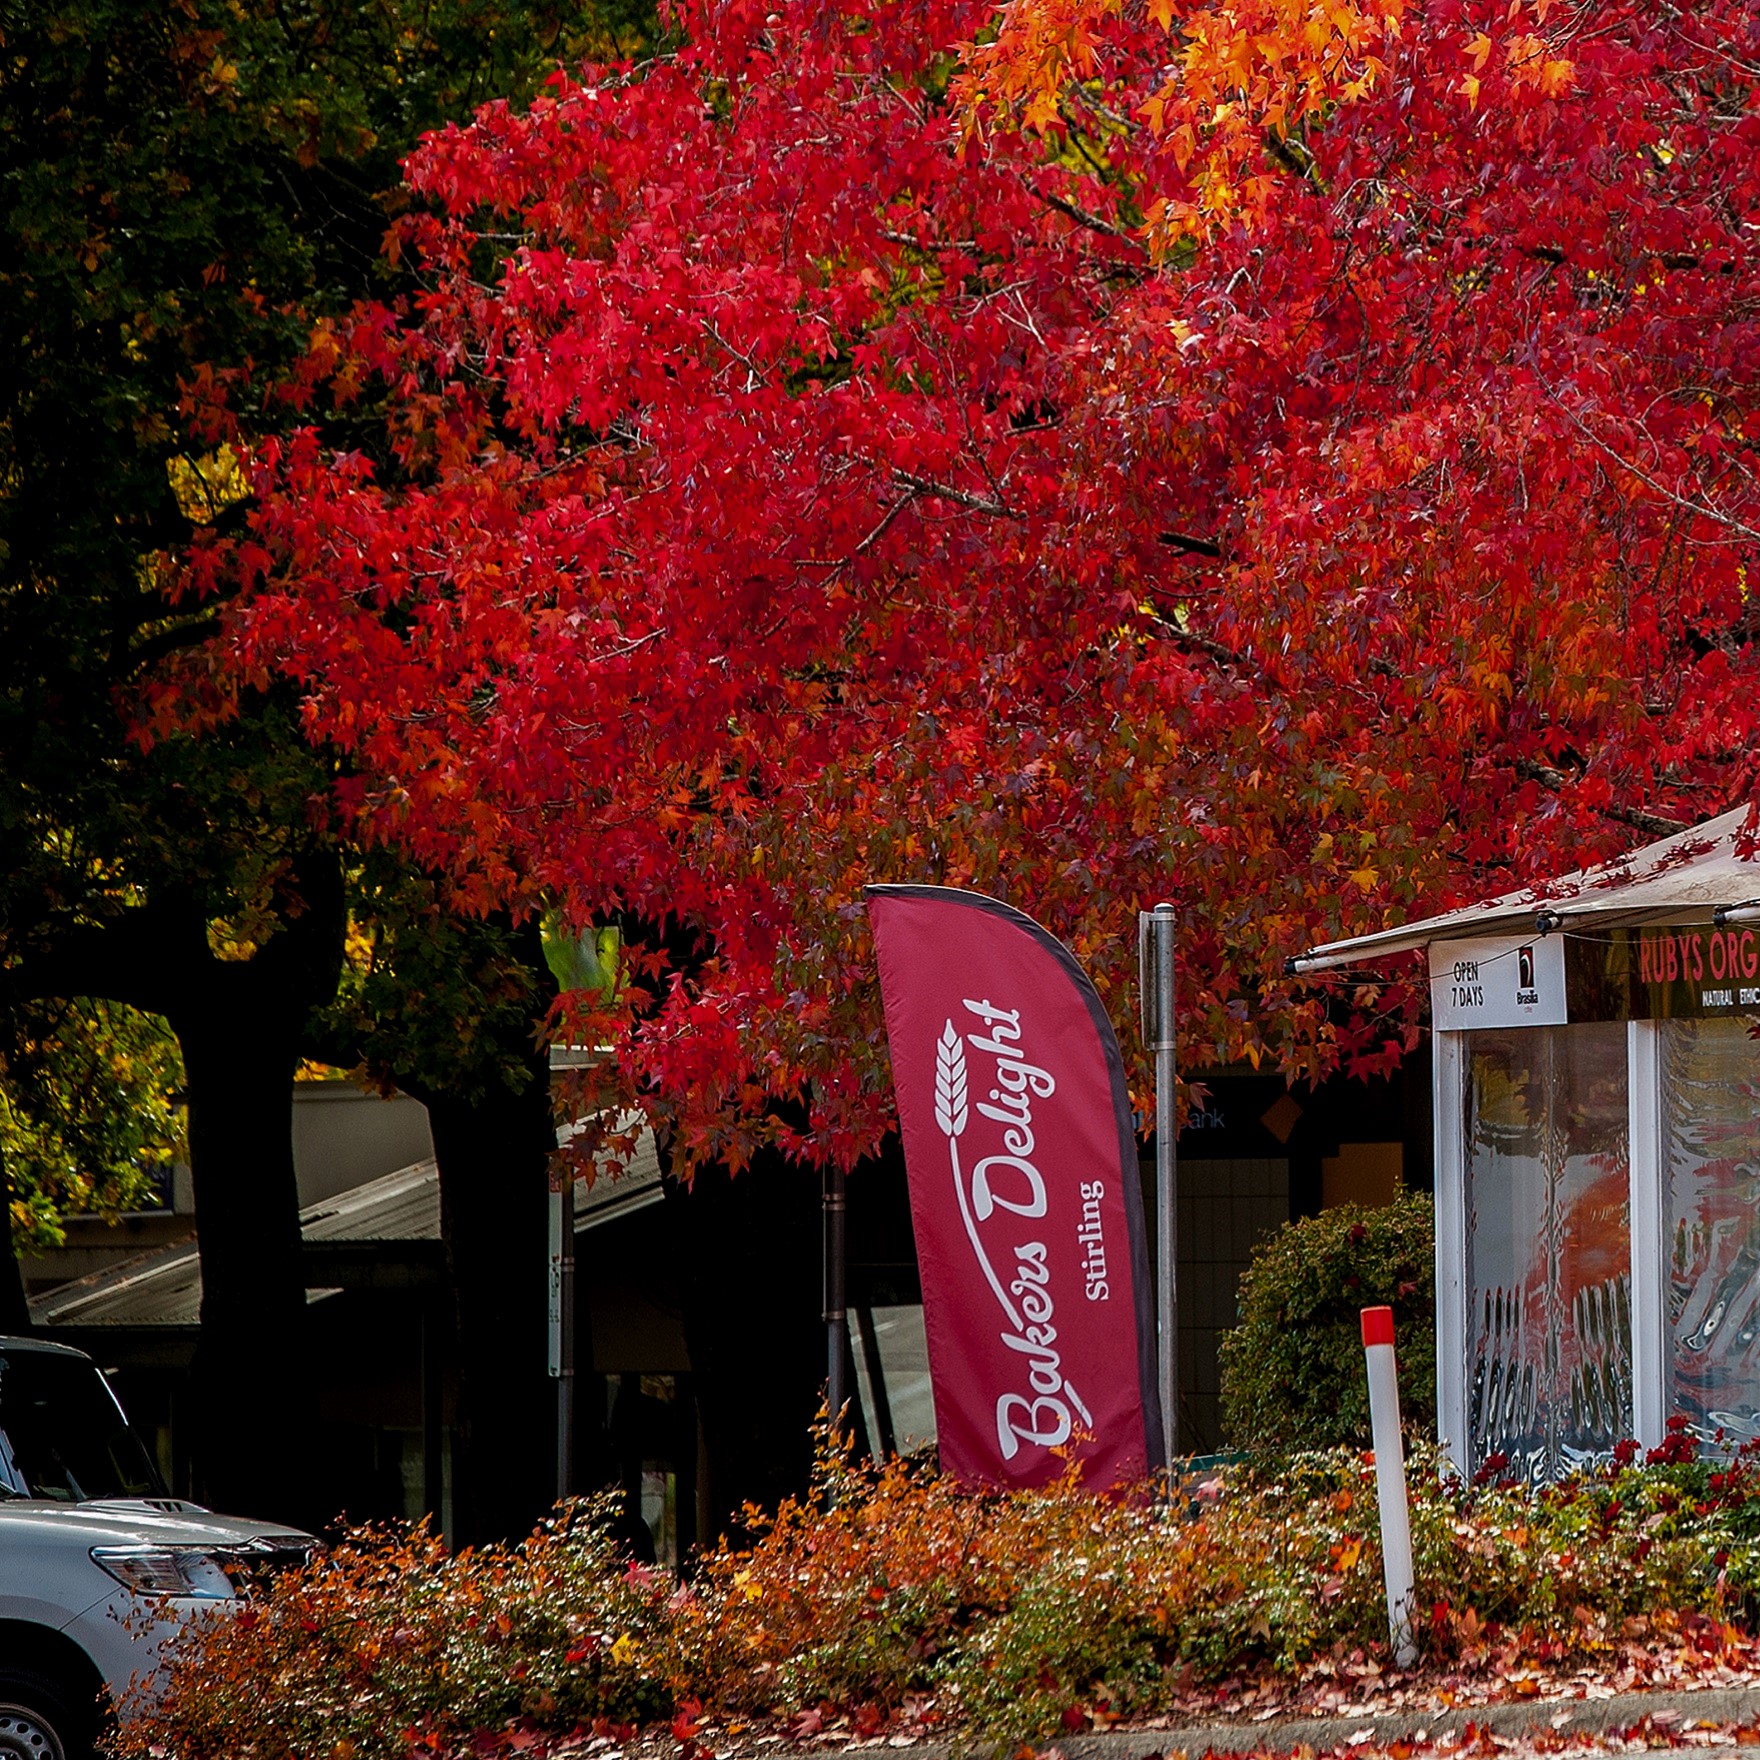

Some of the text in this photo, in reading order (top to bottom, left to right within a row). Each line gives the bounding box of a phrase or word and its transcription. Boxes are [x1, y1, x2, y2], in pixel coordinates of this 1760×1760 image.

[1453, 960, 1479, 982] OPEN
[1640, 932, 1702, 983] RUBYS
[1452, 985, 1484, 1008] 7 DAYS
[1702, 989, 1734, 1007] NATURAL
[962, 998, 1073, 1461] Bakers Delight
[1077, 1180, 1109, 1302] Stirling
